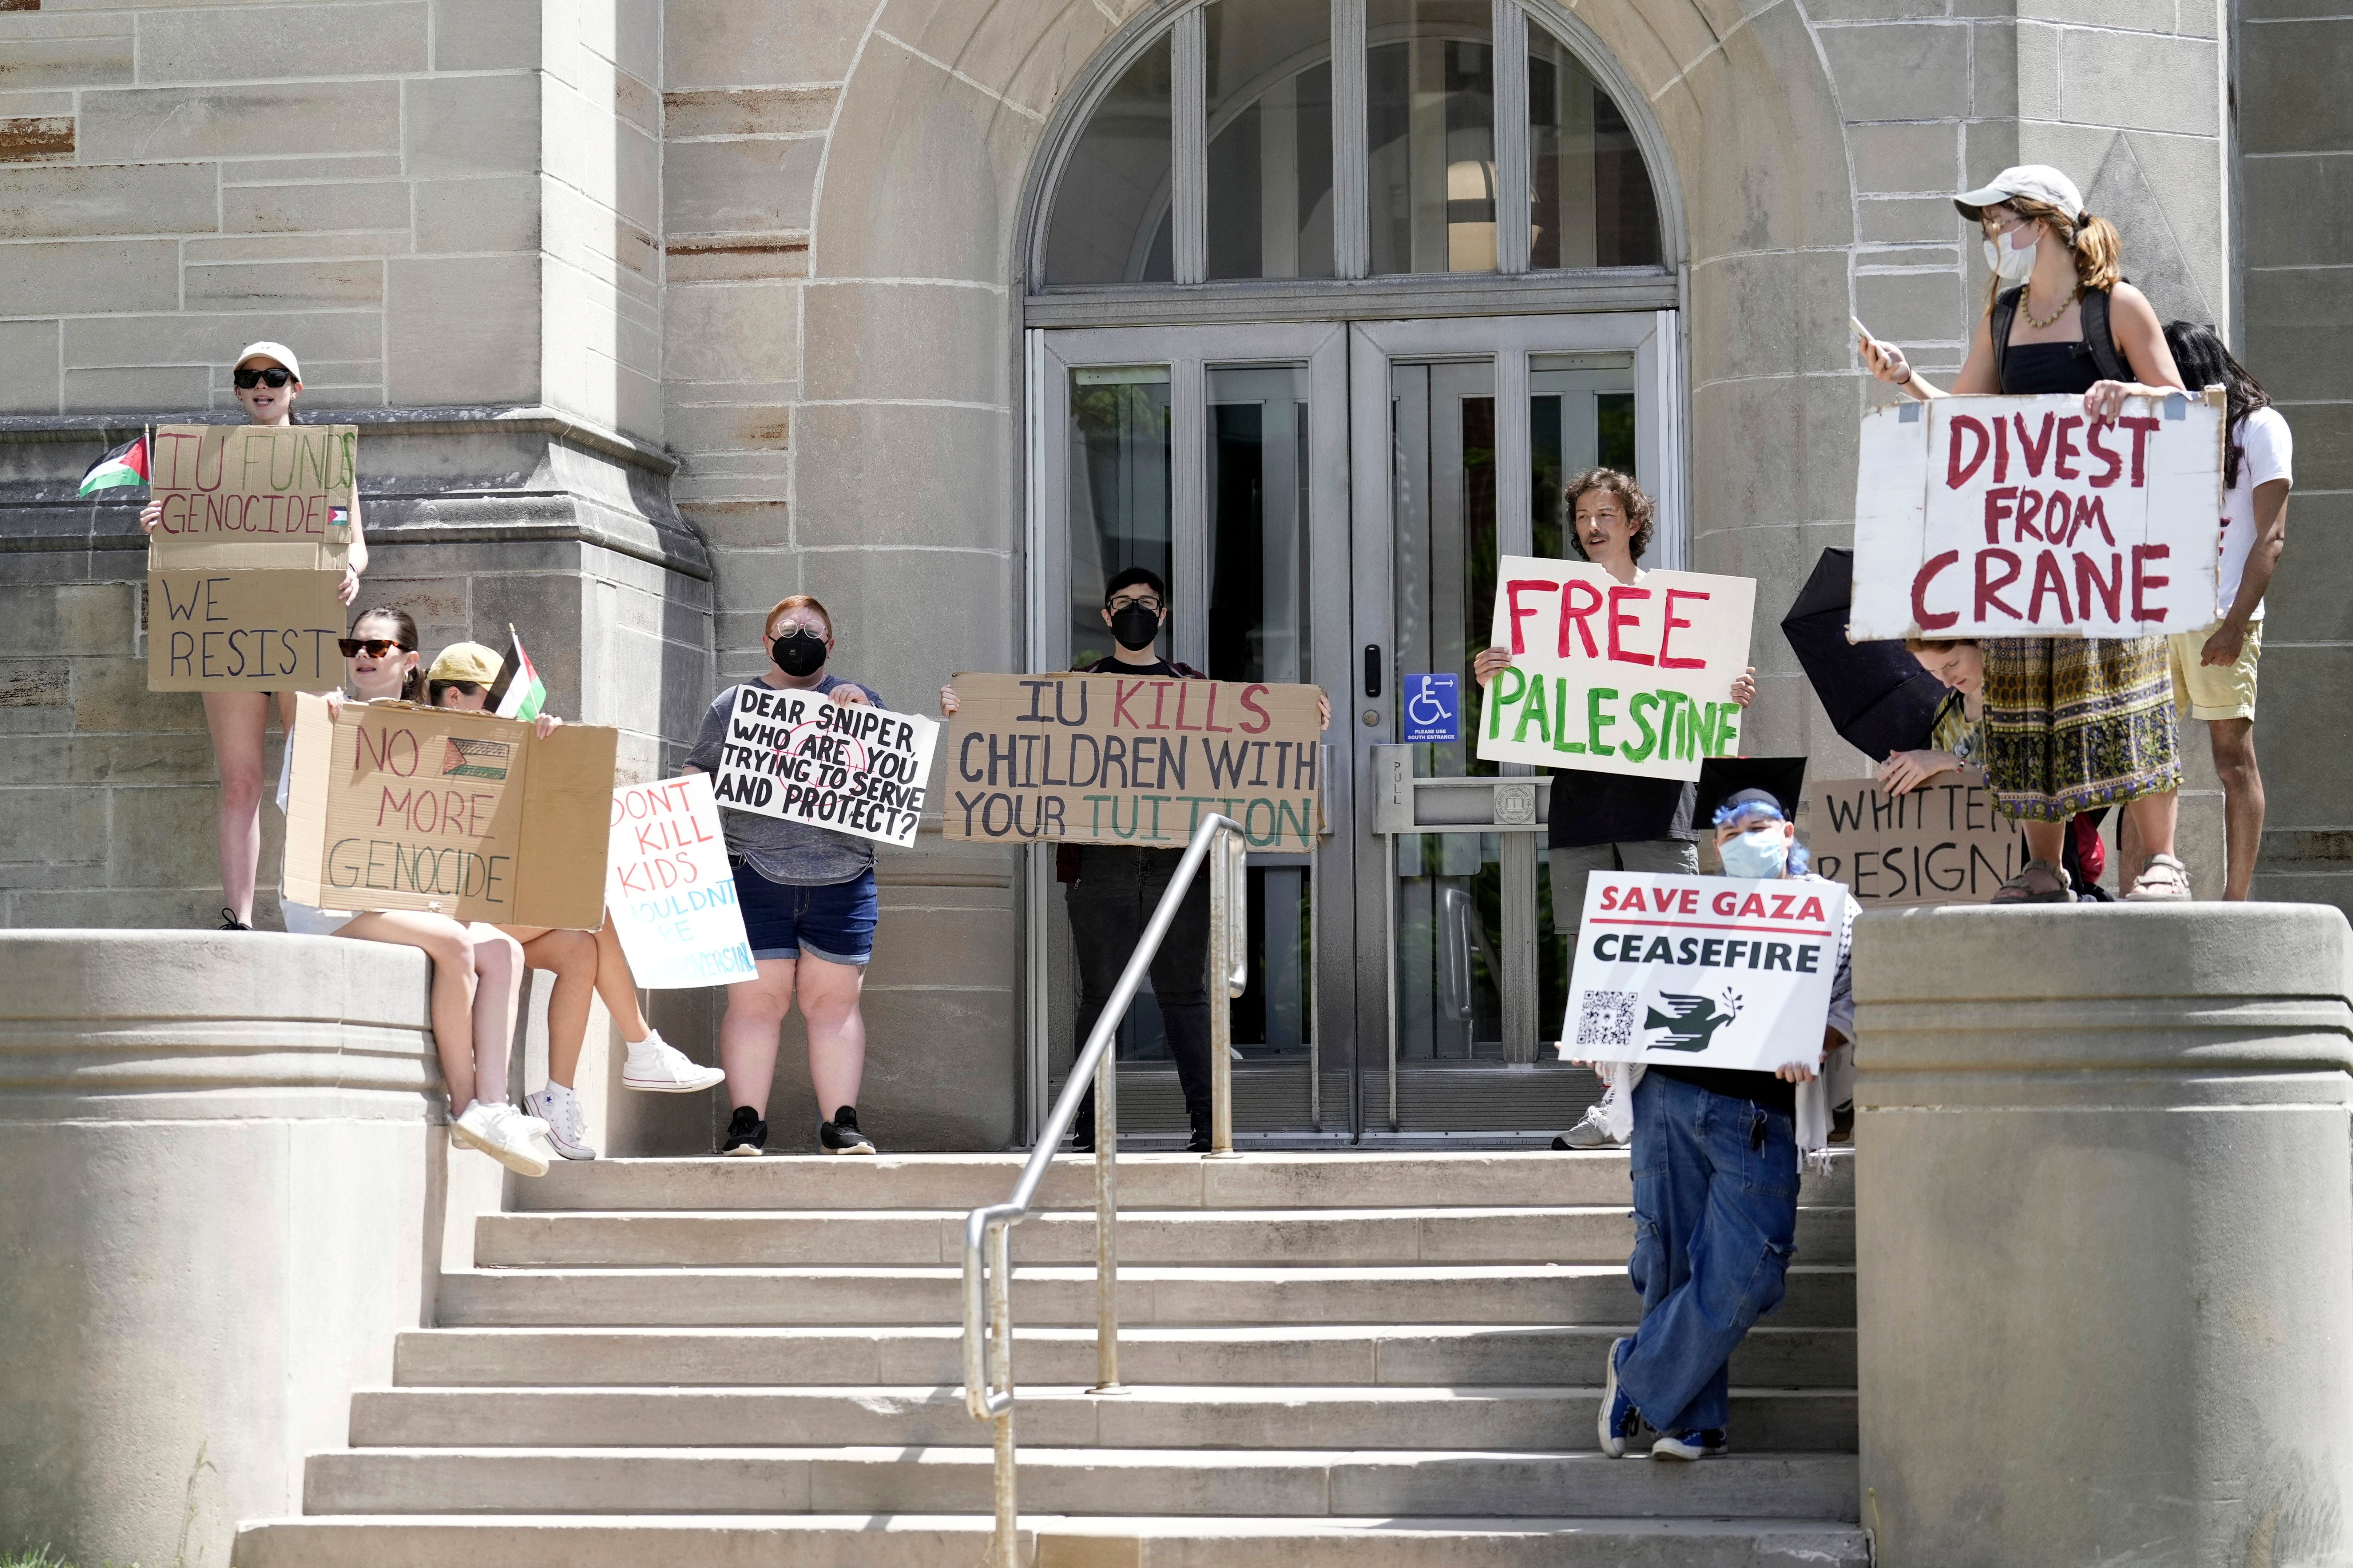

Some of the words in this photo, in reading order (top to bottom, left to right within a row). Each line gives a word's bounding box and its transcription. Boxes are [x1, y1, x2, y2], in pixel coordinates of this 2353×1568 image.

[155, 433, 224, 492] IU
[242, 432, 355, 492] FUNDS
[1946, 411, 2160, 489] DIVEST
[161, 494, 326, 534] GENOCIDE
[1985, 486, 2116, 548] FROM
[162, 577, 230, 621] WE
[1911, 543, 2169, 630] CRANE
[1507, 579, 1710, 669] FREE
[171, 629, 337, 678] RESIST
[741, 689, 805, 724] DEAR
[816, 704, 917, 758] SNIPER,
[1016, 680, 1087, 727] IU
[1113, 679, 1271, 733] KILLS
[355, 726, 418, 777] NO
[724, 744, 811, 782] TRYING
[818, 764, 846, 789] TO
[849, 771, 925, 812] SERVE
[734, 719, 790, 750] WHO
[799, 735, 850, 765] ARE
[867, 746, 918, 784] YOU
[960, 732, 1187, 789] CHILDREN
[1202, 740, 1316, 790] WITH
[377, 786, 495, 839] MORE
[715, 773, 772, 807] AND
[782, 784, 917, 840] PROTECT?
[955, 790, 1065, 837] YOUR
[635, 816, 713, 854] KILL
[329, 838, 509, 902] GENOCIDE
[618, 852, 697, 898] KIDS
[1600, 886, 1699, 914] SAVE
[1712, 891, 1826, 922] GAZA
[1593, 934, 1820, 974] CEASEFIRE
